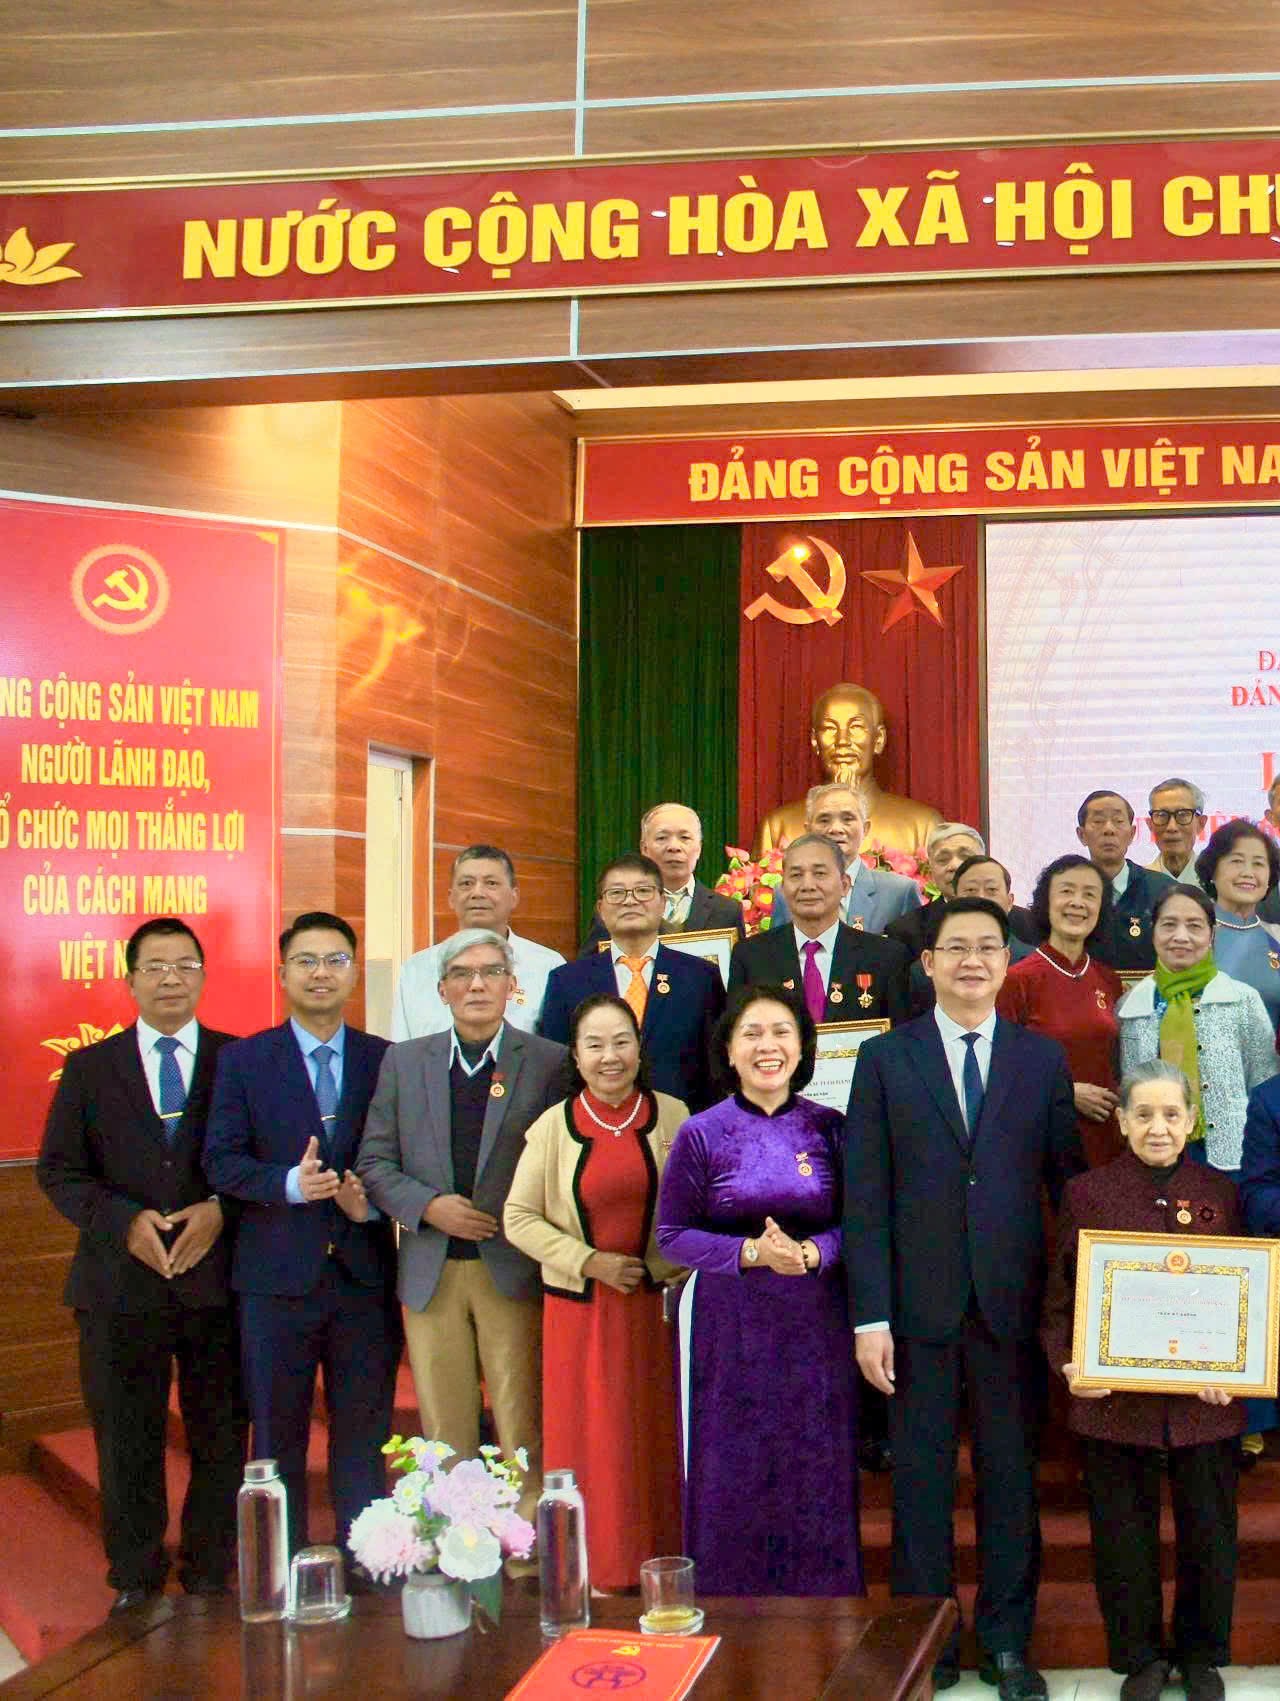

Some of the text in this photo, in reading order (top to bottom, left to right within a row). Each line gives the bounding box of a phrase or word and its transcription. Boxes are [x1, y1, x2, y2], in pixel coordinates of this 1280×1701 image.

[183, 198, 397, 279] NƯỚC
[423, 191, 640, 280] CỘNG
[668, 175, 829, 256] HÒA
[856, 169, 969, 248] XÃ
[995, 162, 1133, 256] HỘI
[688, 445, 819, 502] ĐẢNG
[838, 445, 968, 505] CỘNG
[985, 436, 1085, 492] SẢN
[1102, 437, 1206, 496] VIỆT
[39, 671, 102, 729] CỘNG
[108, 671, 154, 724] SẢN
[160, 679, 205, 734] VIỆT
[210, 688, 259, 728] NAM
[21, 736, 211, 797] NGƯỜI LÃNH ĐẠO,
[17, 801, 80, 850] CHỨC
[86, 810, 129, 860] MỌI
[136, 797, 207, 851] THẮNG
[212, 809, 245, 861] LỢI
[23, 861, 70, 915] CỦA
[76, 865, 136, 915] CÁCH
[59, 931, 107, 989] VIỆT
